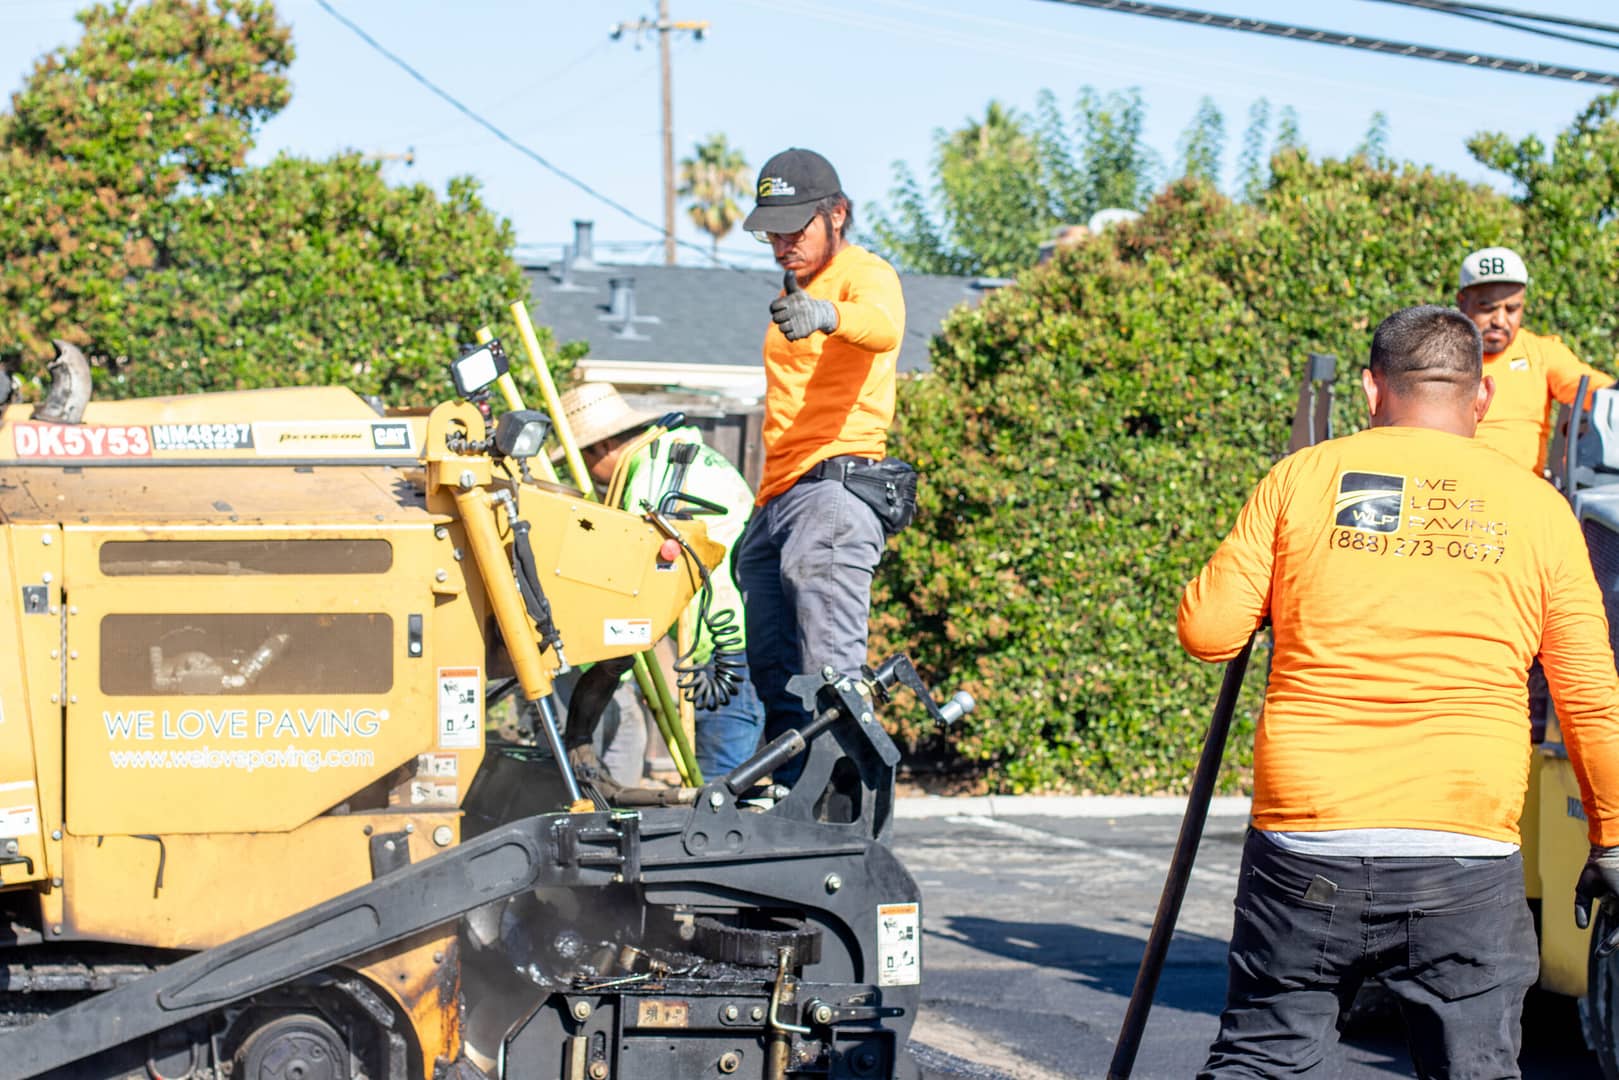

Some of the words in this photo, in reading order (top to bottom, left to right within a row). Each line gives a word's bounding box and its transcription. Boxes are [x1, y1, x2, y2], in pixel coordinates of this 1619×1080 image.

[1479, 257, 1505, 276] SB
[14, 425, 150, 456] DK5Y53
[374, 427, 407, 446] CAT
[1414, 477, 1457, 492] WE
[1410, 496, 1486, 512] LOVE
[1408, 515, 1507, 537] PAVING
[1329, 527, 1389, 556] (888)
[1394, 537, 1505, 564] 273-0077
[103, 709, 154, 740] WE
[161, 709, 248, 739] LOVE
[109, 745, 375, 772] www.welovepaving.com
